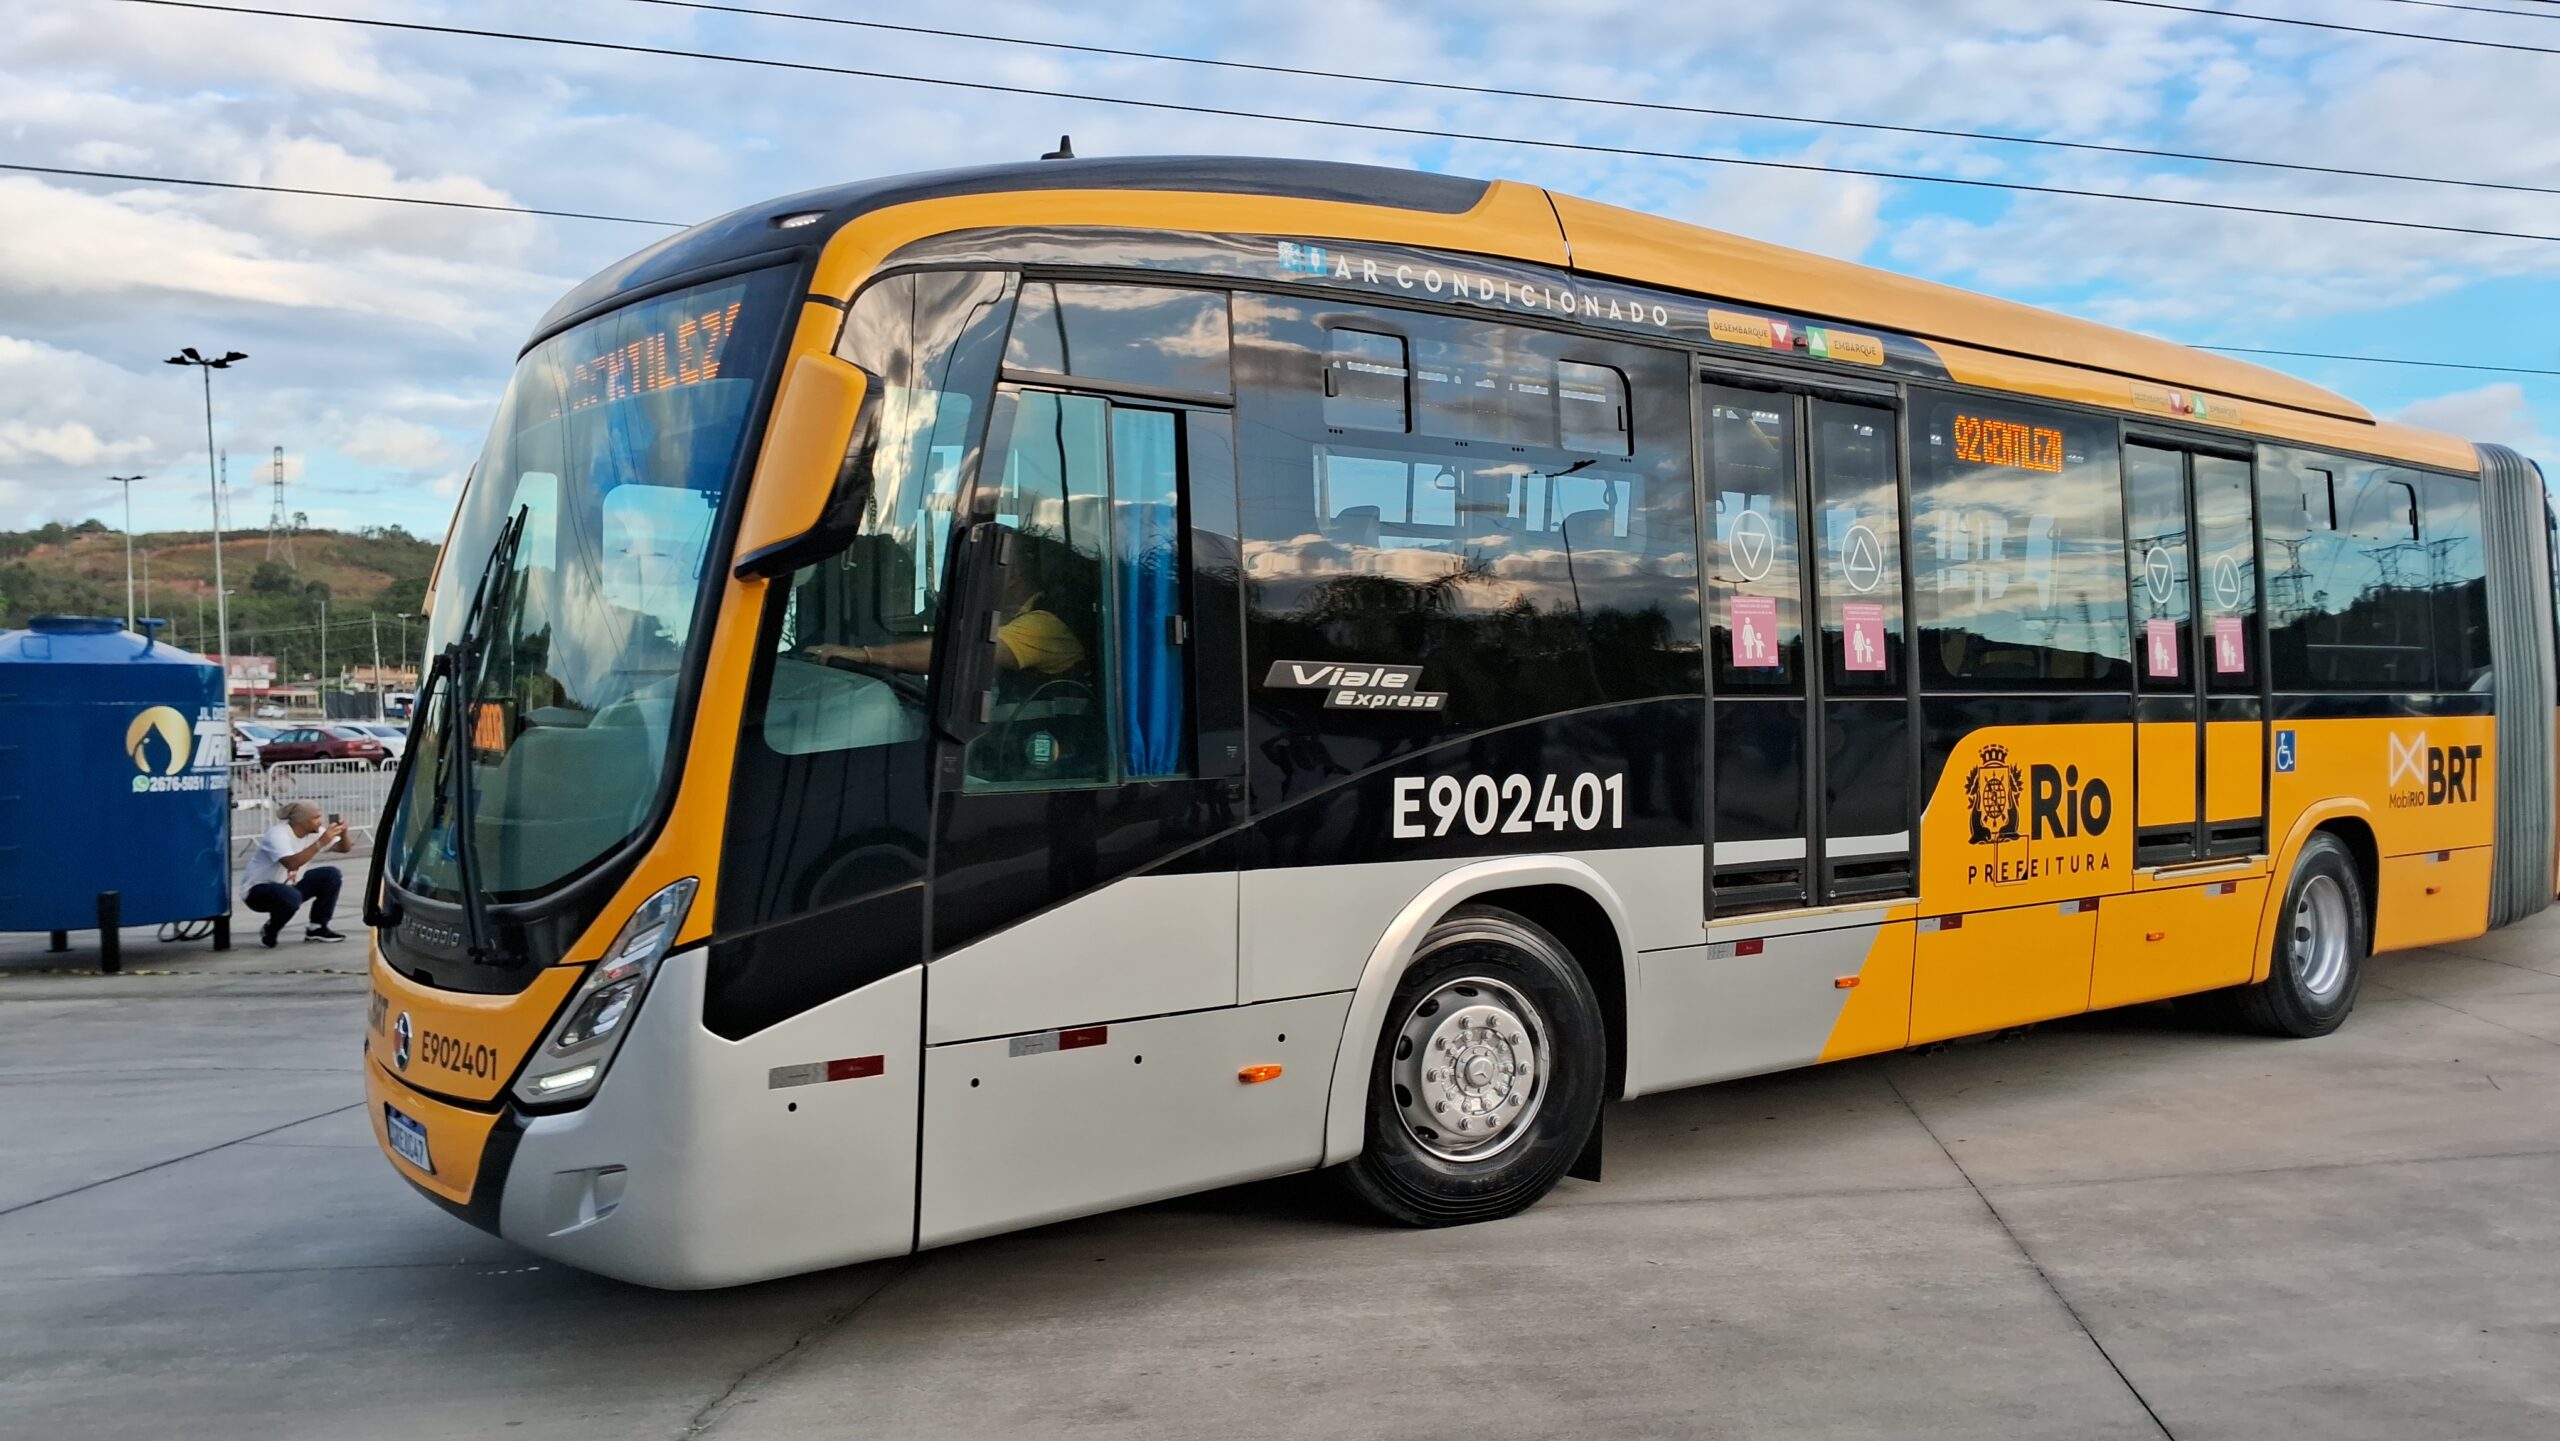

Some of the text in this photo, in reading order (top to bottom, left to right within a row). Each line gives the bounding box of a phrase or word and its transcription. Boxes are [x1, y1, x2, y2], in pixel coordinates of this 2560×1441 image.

[1334, 254, 1668, 327] AR CONDICIONADO
[1713, 322, 1769, 340] DESEMBARQUE
[1834, 340, 1877, 357] EMBARQUE
[1954, 415, 2064, 473] 92 GENTILEZA
[1292, 664, 1409, 688] Viale
[1335, 690, 1439, 709] Express
[2427, 745, 2482, 806] BRT
[1393, 772, 1623, 838] E902401
[2030, 763, 2112, 841] Rio
[1968, 852, 2110, 885] PREFEITURA
[421, 1030, 497, 1081] E902401
